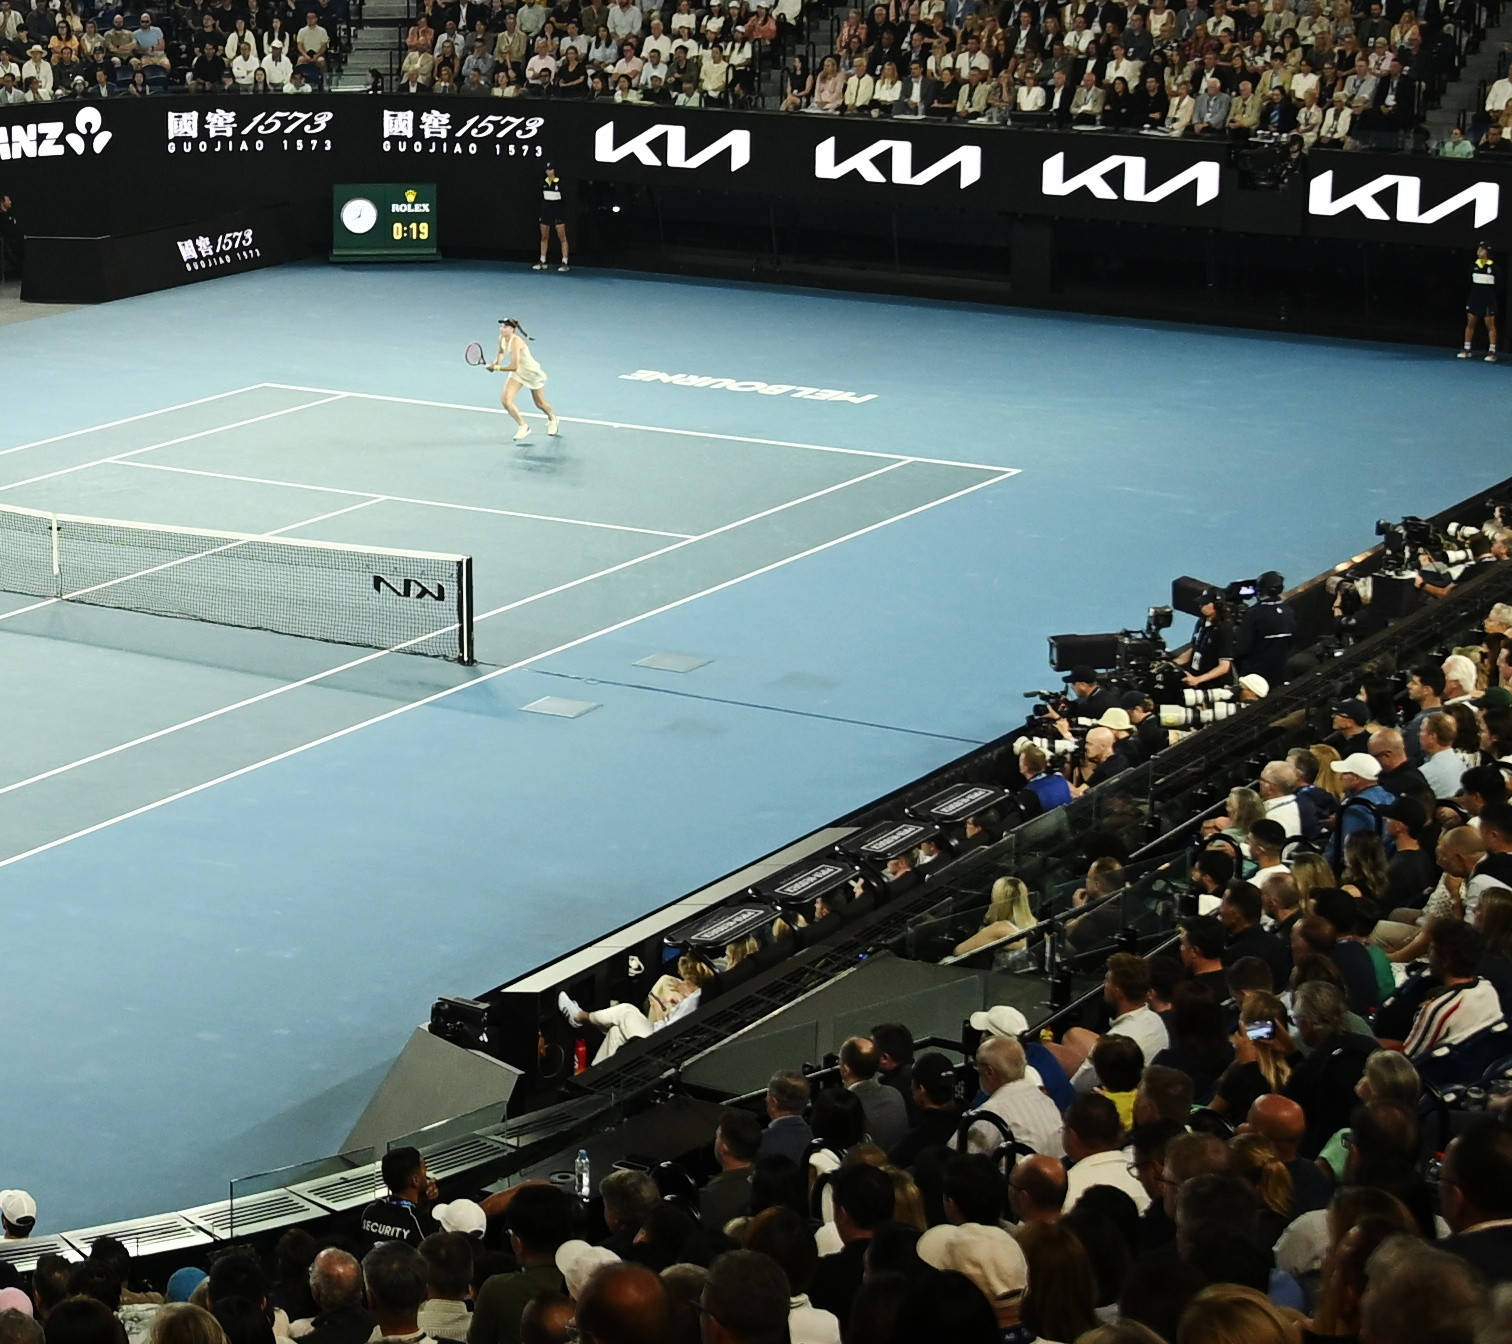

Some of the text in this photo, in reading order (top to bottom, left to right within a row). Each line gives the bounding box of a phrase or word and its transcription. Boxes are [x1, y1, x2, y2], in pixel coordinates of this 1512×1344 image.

[168, 139, 332, 153] GUOJIAO 1573
[383, 140, 543, 157] GUOJIAO 1573
[595, 121, 751, 173] KIA
[815, 136, 982, 190] KIA
[1042, 152, 1220, 207] KIA
[391, 203, 430, 213] ROLEX
[1309, 170, 1500, 229] KIA
[393, 222, 429, 240] 0:19
[617, 369, 879, 404] MELBOURNE
[362, 1219, 411, 1240] SECURITY
